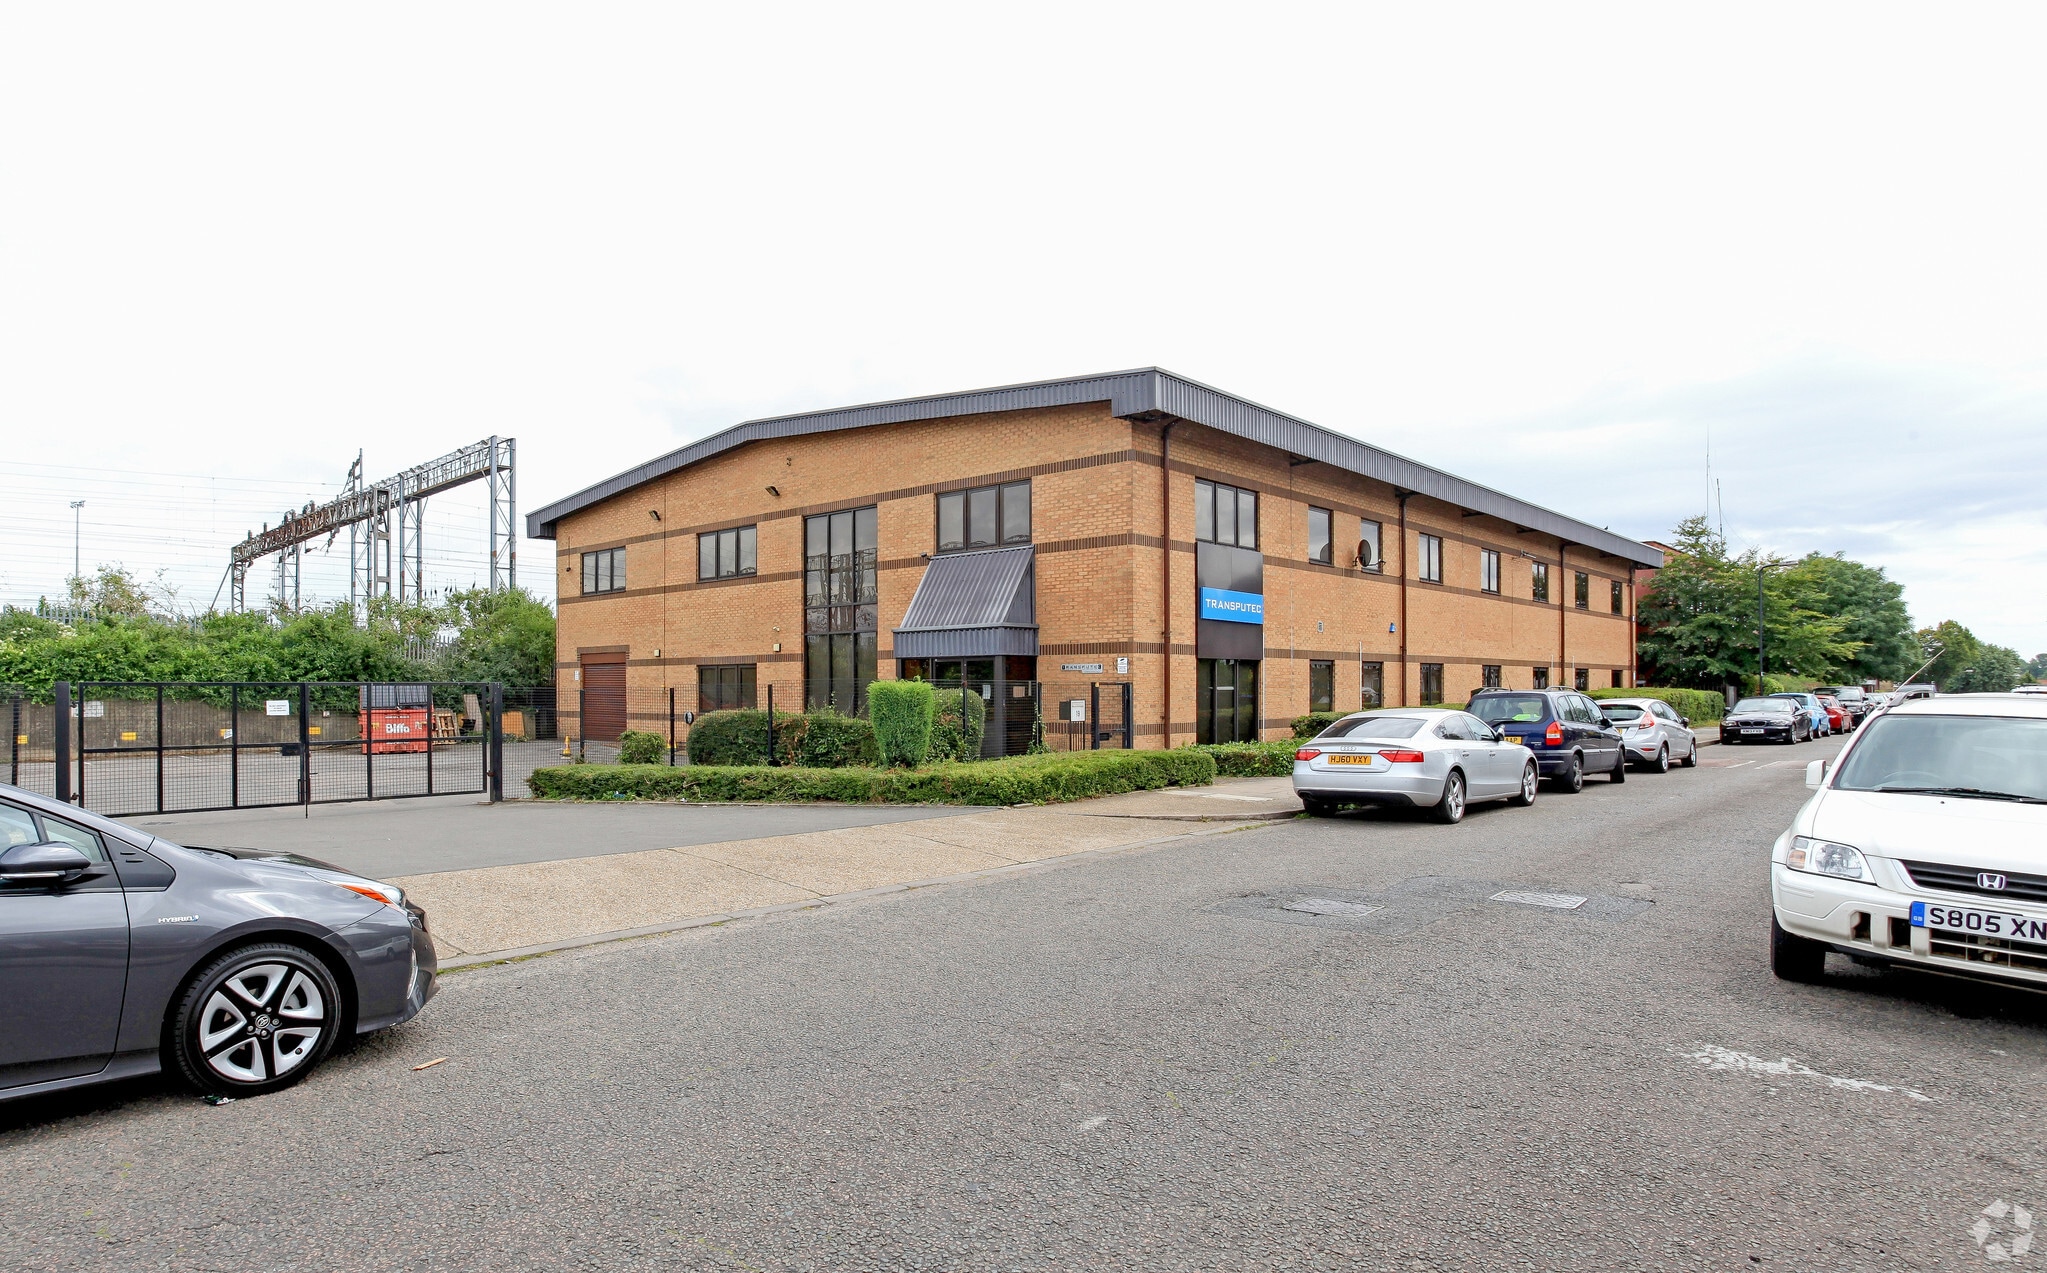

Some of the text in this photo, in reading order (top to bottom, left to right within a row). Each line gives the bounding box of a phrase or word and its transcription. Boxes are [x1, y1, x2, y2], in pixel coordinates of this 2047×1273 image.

[1205, 599, 1261, 613] TRANSPUTEC
[385, 722, 410, 734] Biffa
[1330, 755, 1368, 764] HJ60 VXY
[1929, 907, 2047, 940] S805 XN
